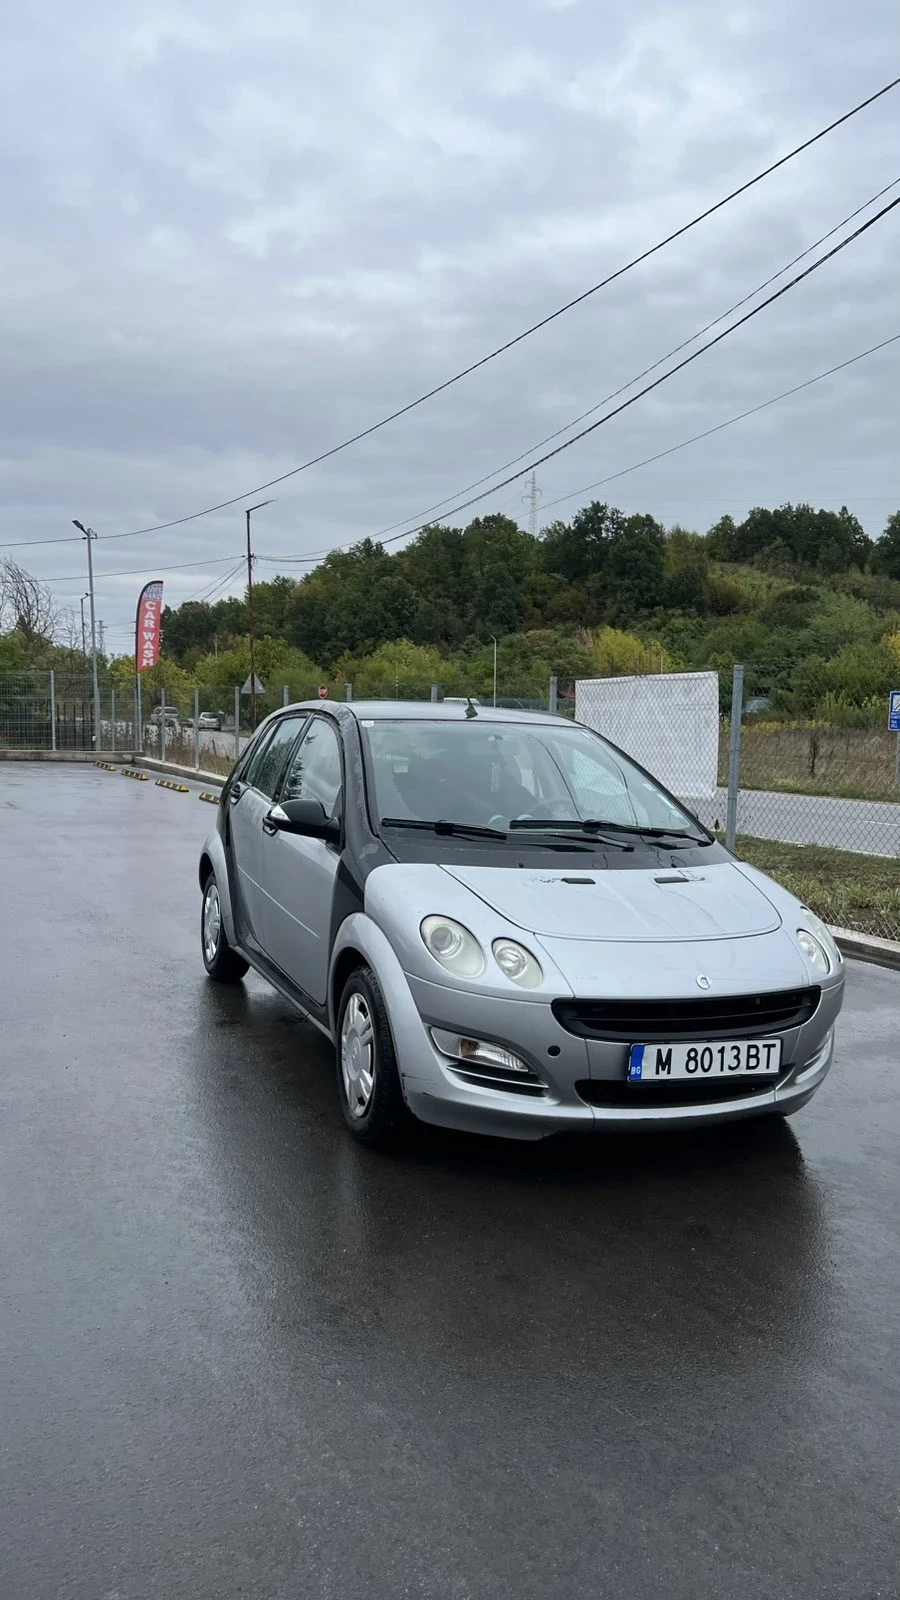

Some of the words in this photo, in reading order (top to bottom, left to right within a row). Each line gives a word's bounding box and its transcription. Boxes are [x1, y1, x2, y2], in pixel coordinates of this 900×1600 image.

[144, 601, 156, 628] CAR
[142, 631, 155, 666] WASH
[630, 1066, 641, 1075] BG
[655, 1048, 672, 1075] M
